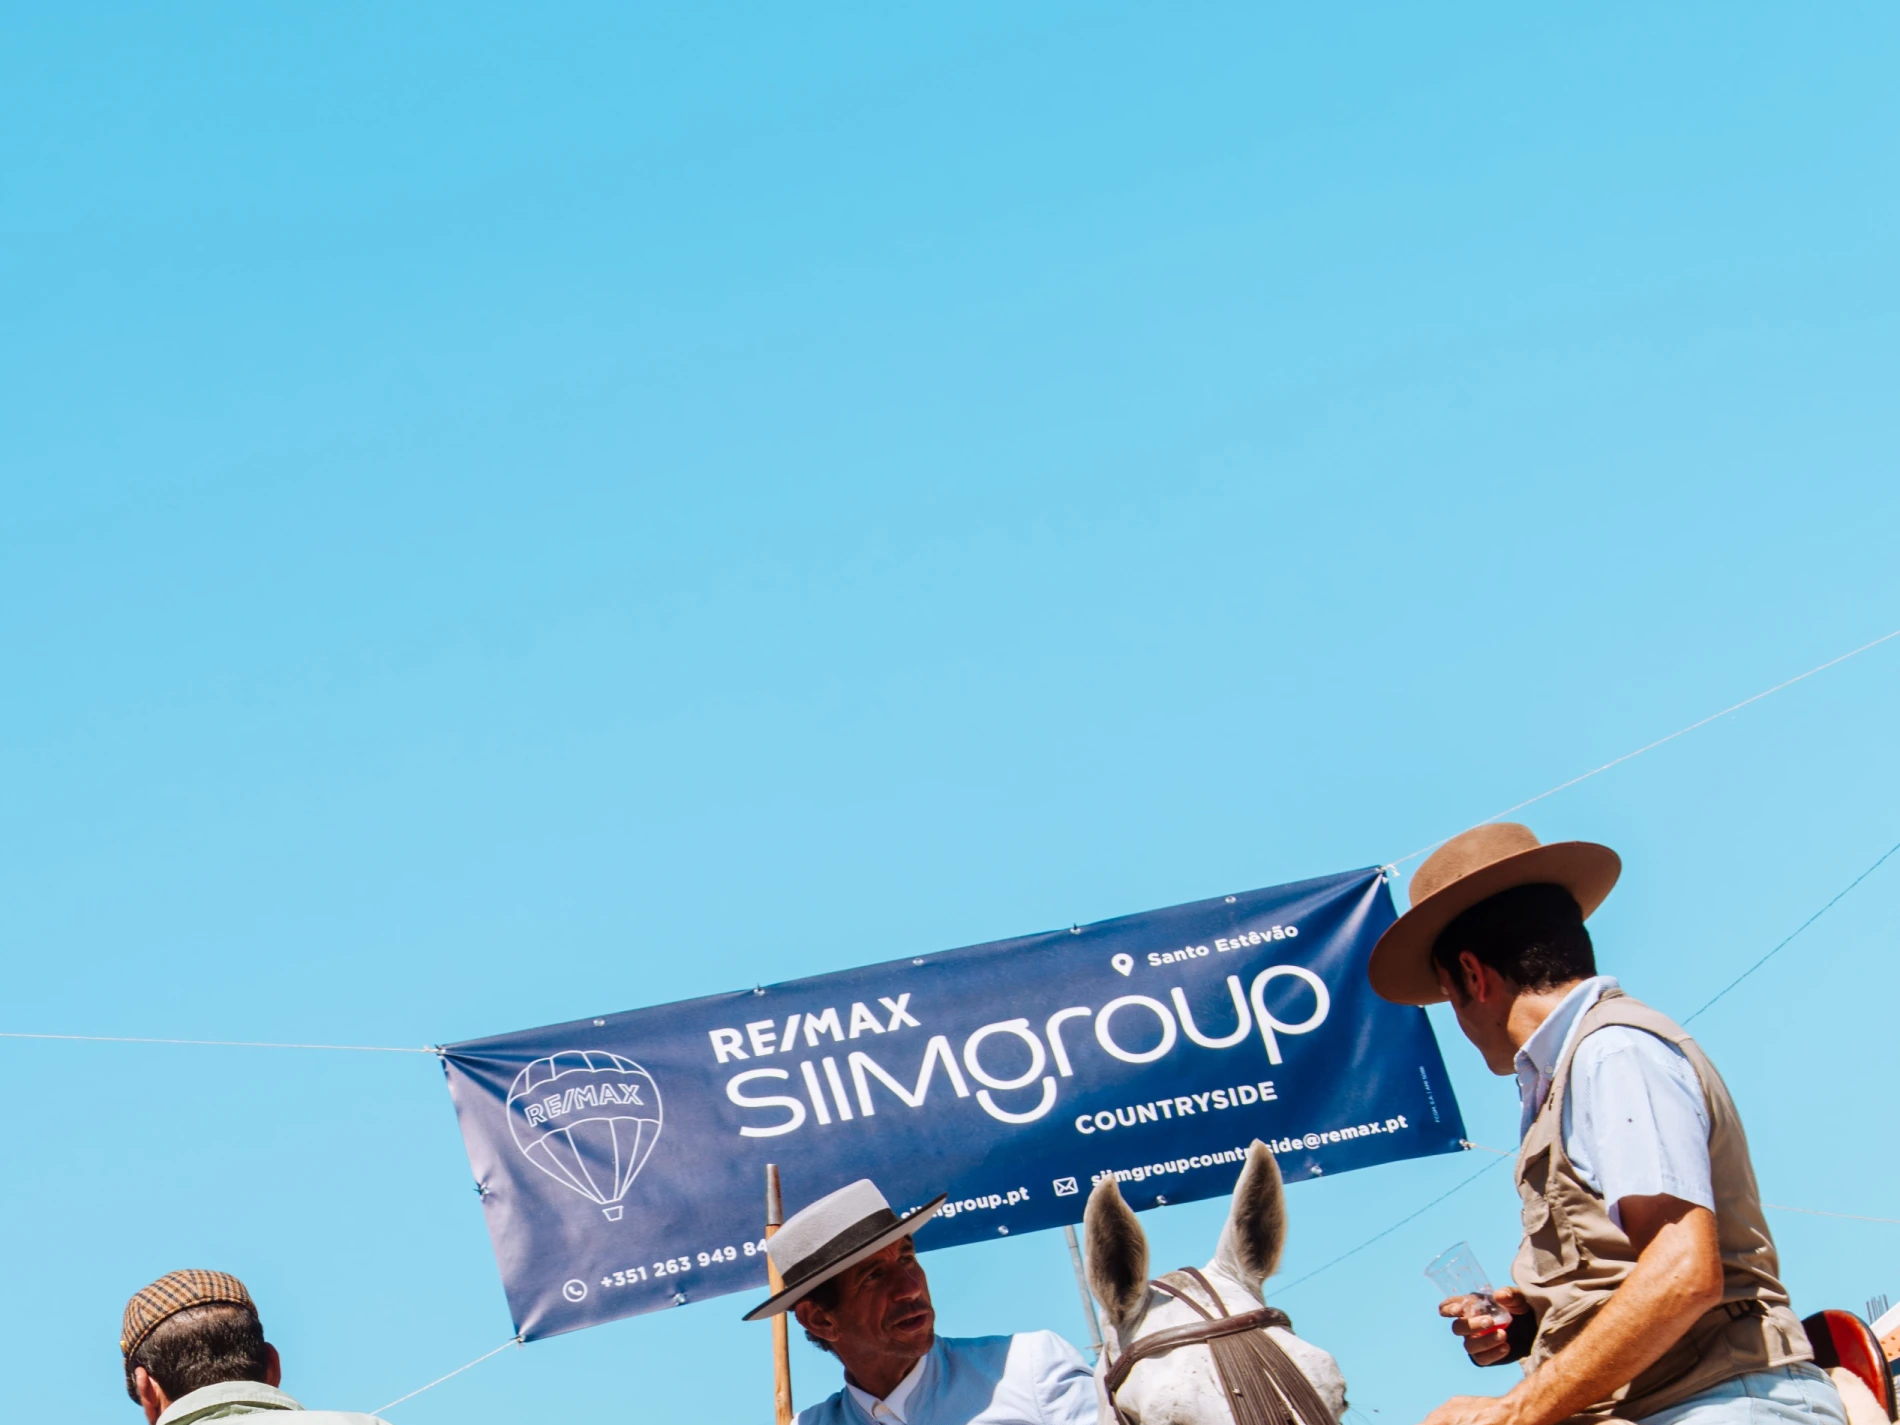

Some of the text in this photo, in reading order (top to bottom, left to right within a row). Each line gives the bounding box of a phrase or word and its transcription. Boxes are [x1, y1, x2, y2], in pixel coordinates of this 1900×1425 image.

[1147, 922, 1299, 967] Santo Estêvão
[709, 992, 922, 1064] RE/MAX
[524, 1083, 645, 1128] RE/MAX
[1075, 1080, 1278, 1135] COUNTRYSIDE
[1091, 1114, 1409, 1188] simgroupcountride@remax.pt
[901, 1186, 1031, 1219] sgroup.pt
[600, 1266, 648, 1288] +351
[652, 1256, 692, 1278] 263
[696, 1246, 737, 1267] 949
